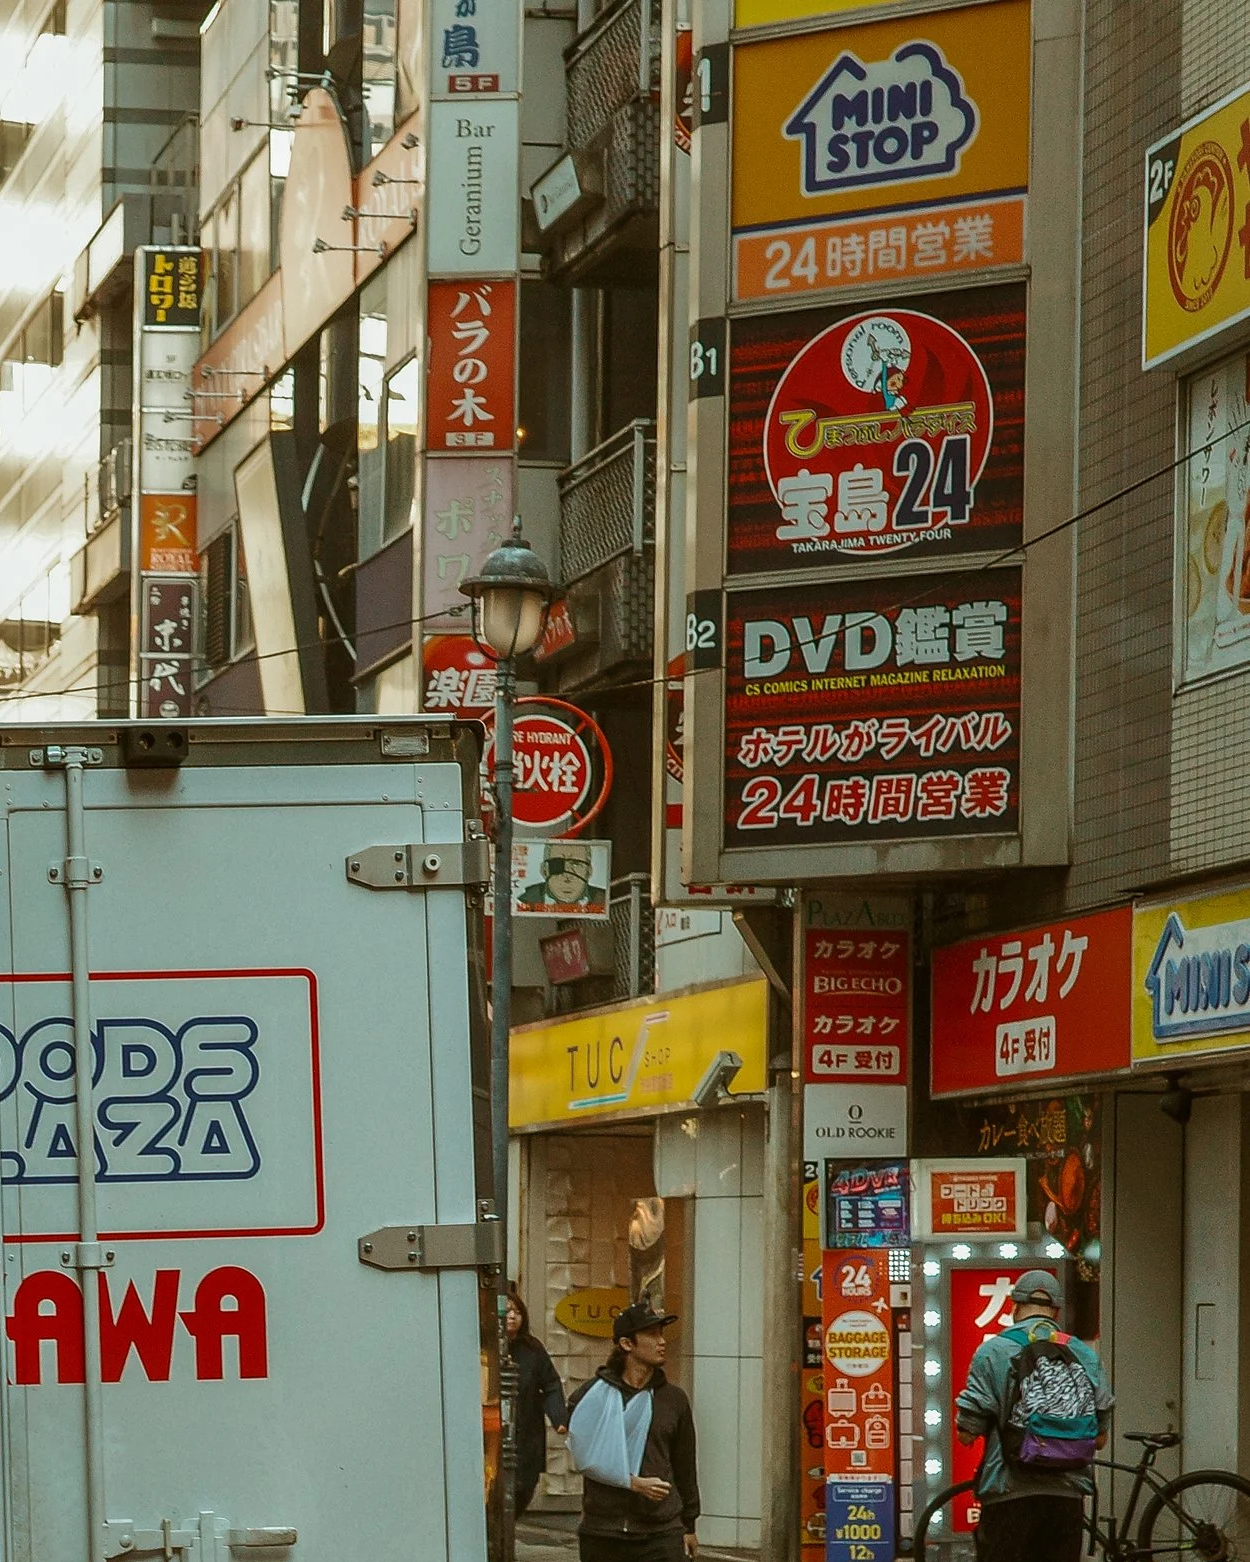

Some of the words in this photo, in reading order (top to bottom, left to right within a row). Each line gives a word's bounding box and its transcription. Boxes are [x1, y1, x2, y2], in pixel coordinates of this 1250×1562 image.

[454, 76, 495, 91] 5F
[831, 78, 934, 132] MINI
[455, 118, 497, 139] Bar
[826, 120, 940, 174] STOP
[1150, 158, 1174, 204] 2F
[458, 145, 484, 257] Geranium
[764, 212, 994, 290] 24時間営業
[445, 284, 495, 427] バラの木
[690, 340, 717, 381] B1
[775, 434, 975, 541] 宝島24
[790, 537, 866, 554] TAKARAJIMA
[868, 531, 917, 547] TWENTY
[919, 528, 952, 542] FOUR
[686, 612, 717, 651] B2
[742, 600, 1008, 680] DVD鑑賞
[423, 668, 500, 709] 楽園
[745, 683, 761, 697] CS
[763, 680, 809, 695] COMICS
[811, 675, 867, 692] INTERNET
[869, 670, 930, 688] MAGAZINE
[932, 664, 1006, 683] RELAXATION
[526, 731, 573, 746] HYDRANT
[737, 711, 1014, 769] ホテルがライバル
[736, 767, 1010, 831] 24時間営業
[813, 940, 901, 960] カラオケ
[813, 975, 849, 994] BIG
[851, 976, 903, 995] ECHO
[969, 928, 1089, 1016] カラオケ
[813, 1014, 900, 1035] カラオケ
[566, 1035, 624, 1093] TUC
[817, 1050, 849, 1069] 4F
[854, 1050, 895, 1071] 受付
[999, 1028, 1020, 1066] 4F
[1023, 1026, 1051, 1063] 受付
[815, 1127, 846, 1139] OLD
[848, 1127, 896, 1140] ROOKIE
[841, 1264, 872, 1287] 24
[4, 1264, 270, 1386] AWA
[568, 1303, 621, 1320] TUC
[828, 1331, 887, 1344] BAGGAGE
[828, 1346, 887, 1359] STORAGE
[846, 1505, 876, 1521] 24h
[836, 1524, 881, 1540] ¥1000
[849, 1545, 875, 1560] 12h
